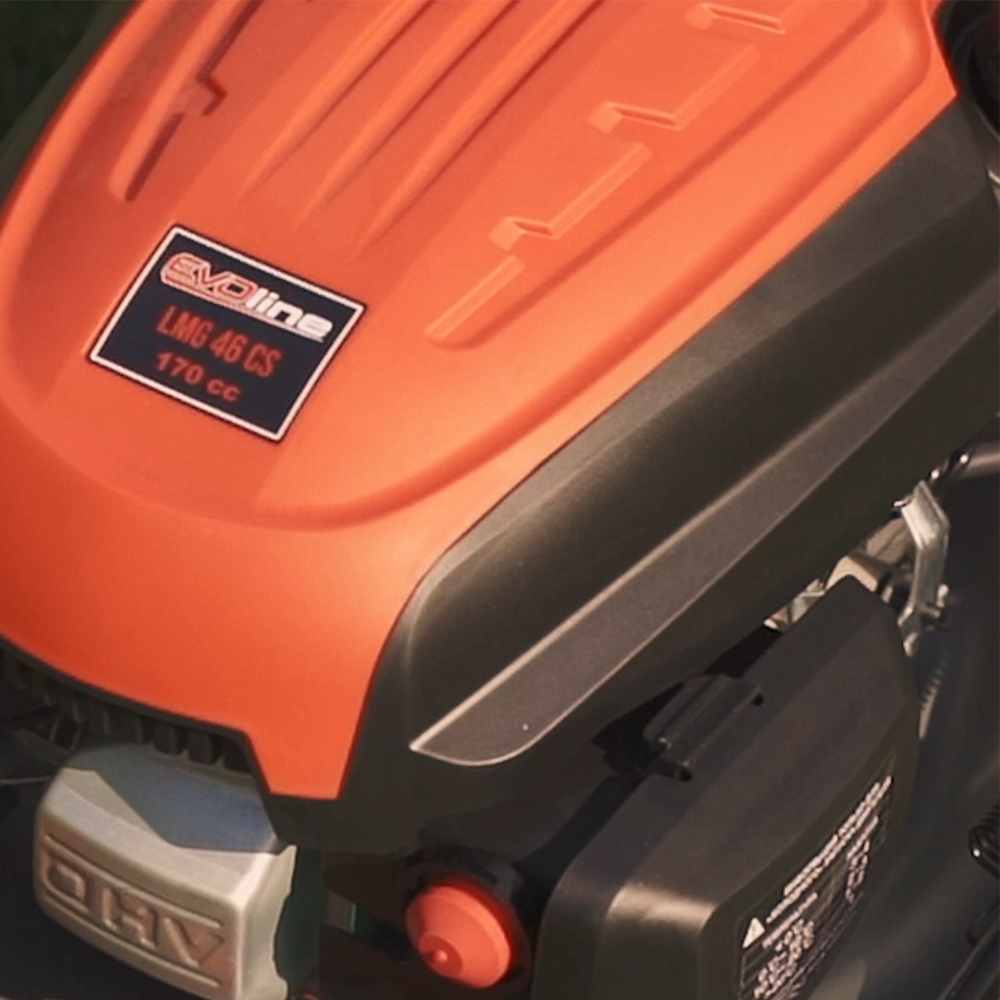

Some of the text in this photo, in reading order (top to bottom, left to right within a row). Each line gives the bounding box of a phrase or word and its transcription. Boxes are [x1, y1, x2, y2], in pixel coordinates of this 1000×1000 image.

[160, 252, 333, 341] EVOline
[157, 305, 282, 378] LMG 46 CS
[157, 352, 241, 401] 170 cc
[42, 850, 226, 970] OHV
